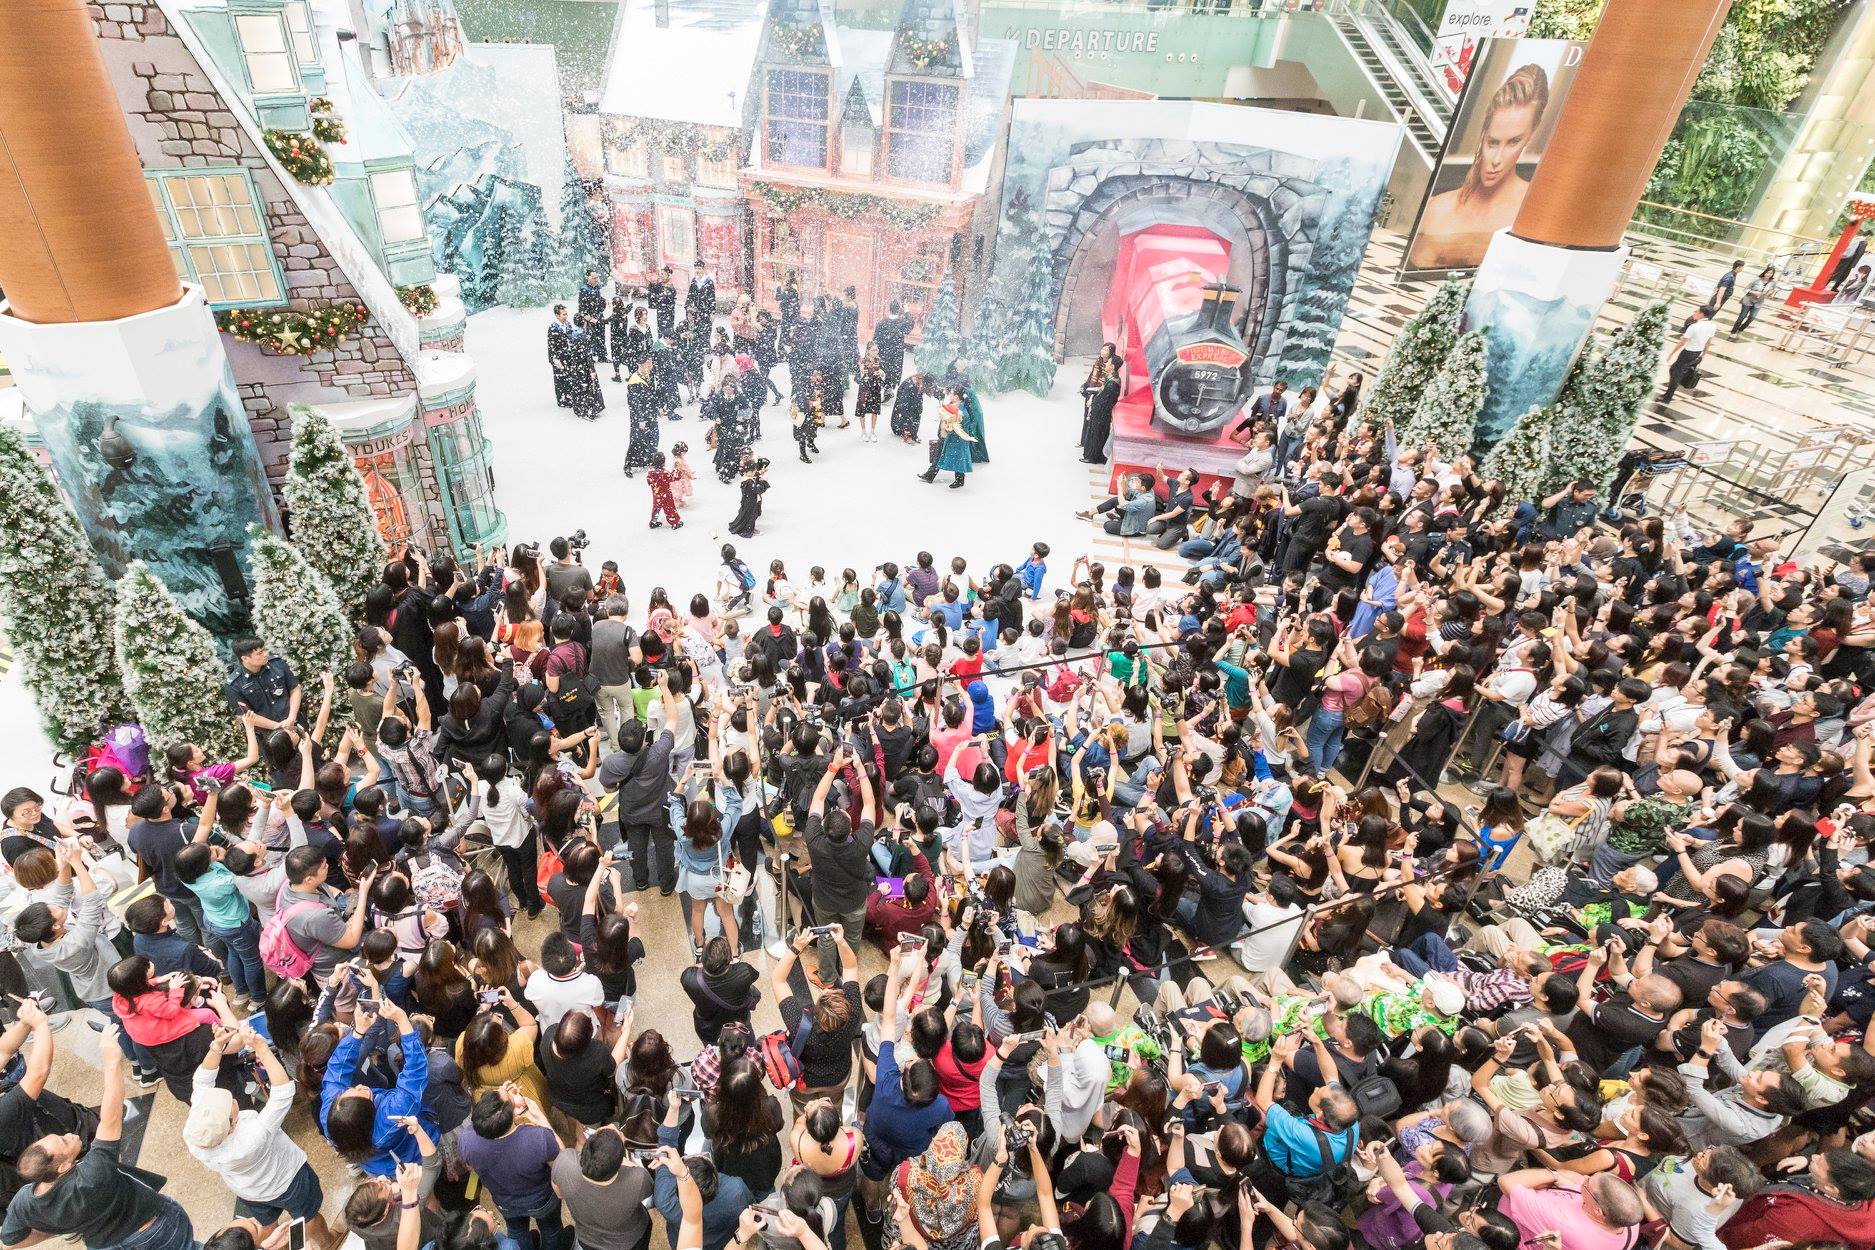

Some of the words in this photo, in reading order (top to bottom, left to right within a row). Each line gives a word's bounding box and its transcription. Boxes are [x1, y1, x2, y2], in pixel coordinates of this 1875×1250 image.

[1448, 12, 1493, 27] explore.
[1026, 27, 1160, 52] DEPARTURE
[1194, 370, 1218, 381] 5972
